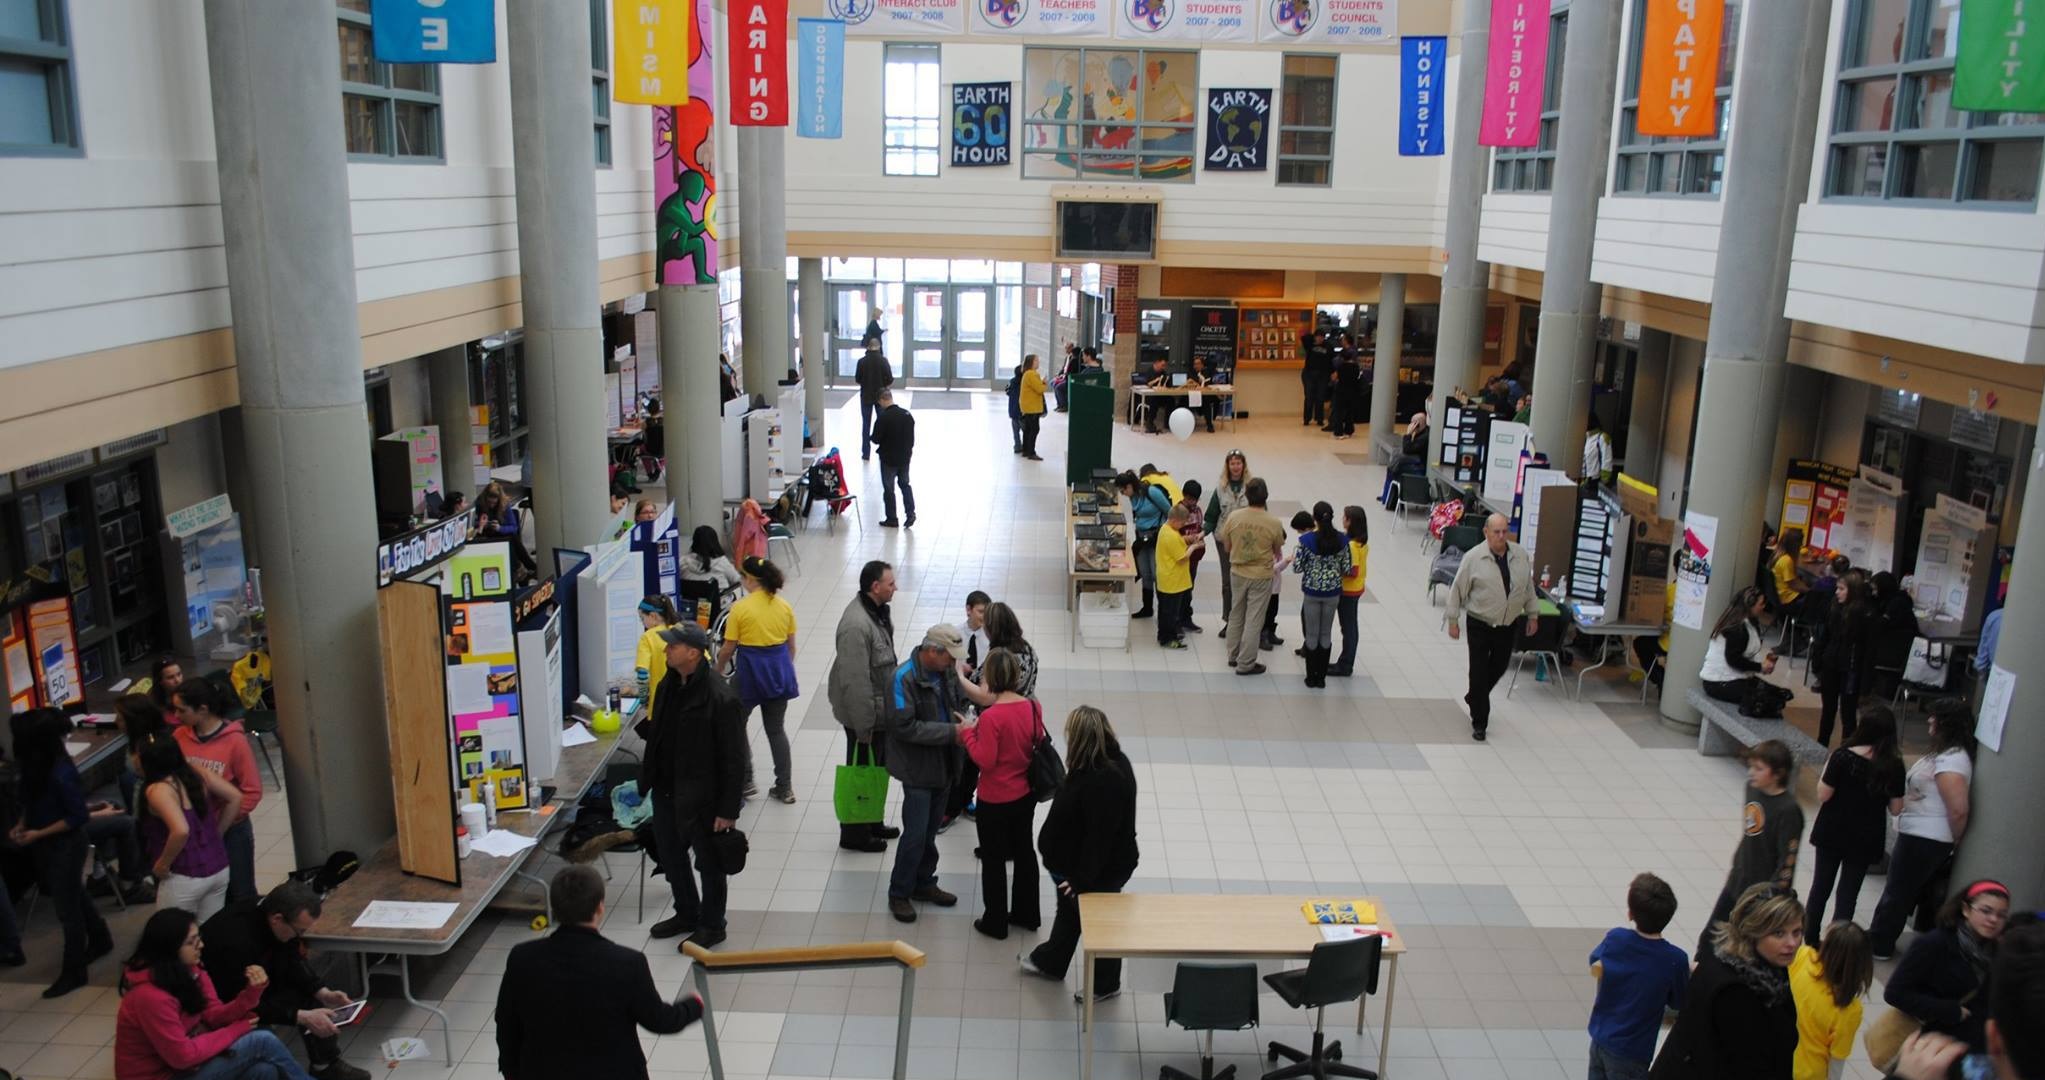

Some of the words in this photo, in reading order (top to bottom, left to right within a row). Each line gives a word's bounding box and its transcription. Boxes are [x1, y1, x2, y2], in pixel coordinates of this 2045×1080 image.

[1040, 0, 1096, 9] TEACHERS
[1186, 4, 1243, 14] STUDENTS
[1328, 0, 1384, 10] STUDENTS
[891, 11, 913, 20] 2007
[922, 11, 944, 20] 2008
[1040, 12, 1063, 21] 2007
[1072, 13, 1096, 22] 2008
[1331, 13, 1378, 23] COUNCIL
[1186, 17, 1209, 26] 2007
[1217, 18, 1242, 26] 2008
[1327, 26, 1350, 35] 2007
[1360, 27, 1382, 35] 2008
[954, 86, 1009, 104] EARTH
[1210, 91, 1268, 114] EARTH
[954, 104, 1007, 147] 60
[953, 146, 1007, 163] HOUR
[1208, 144, 1257, 168] DAY
[52, 674, 66, 694] 50
